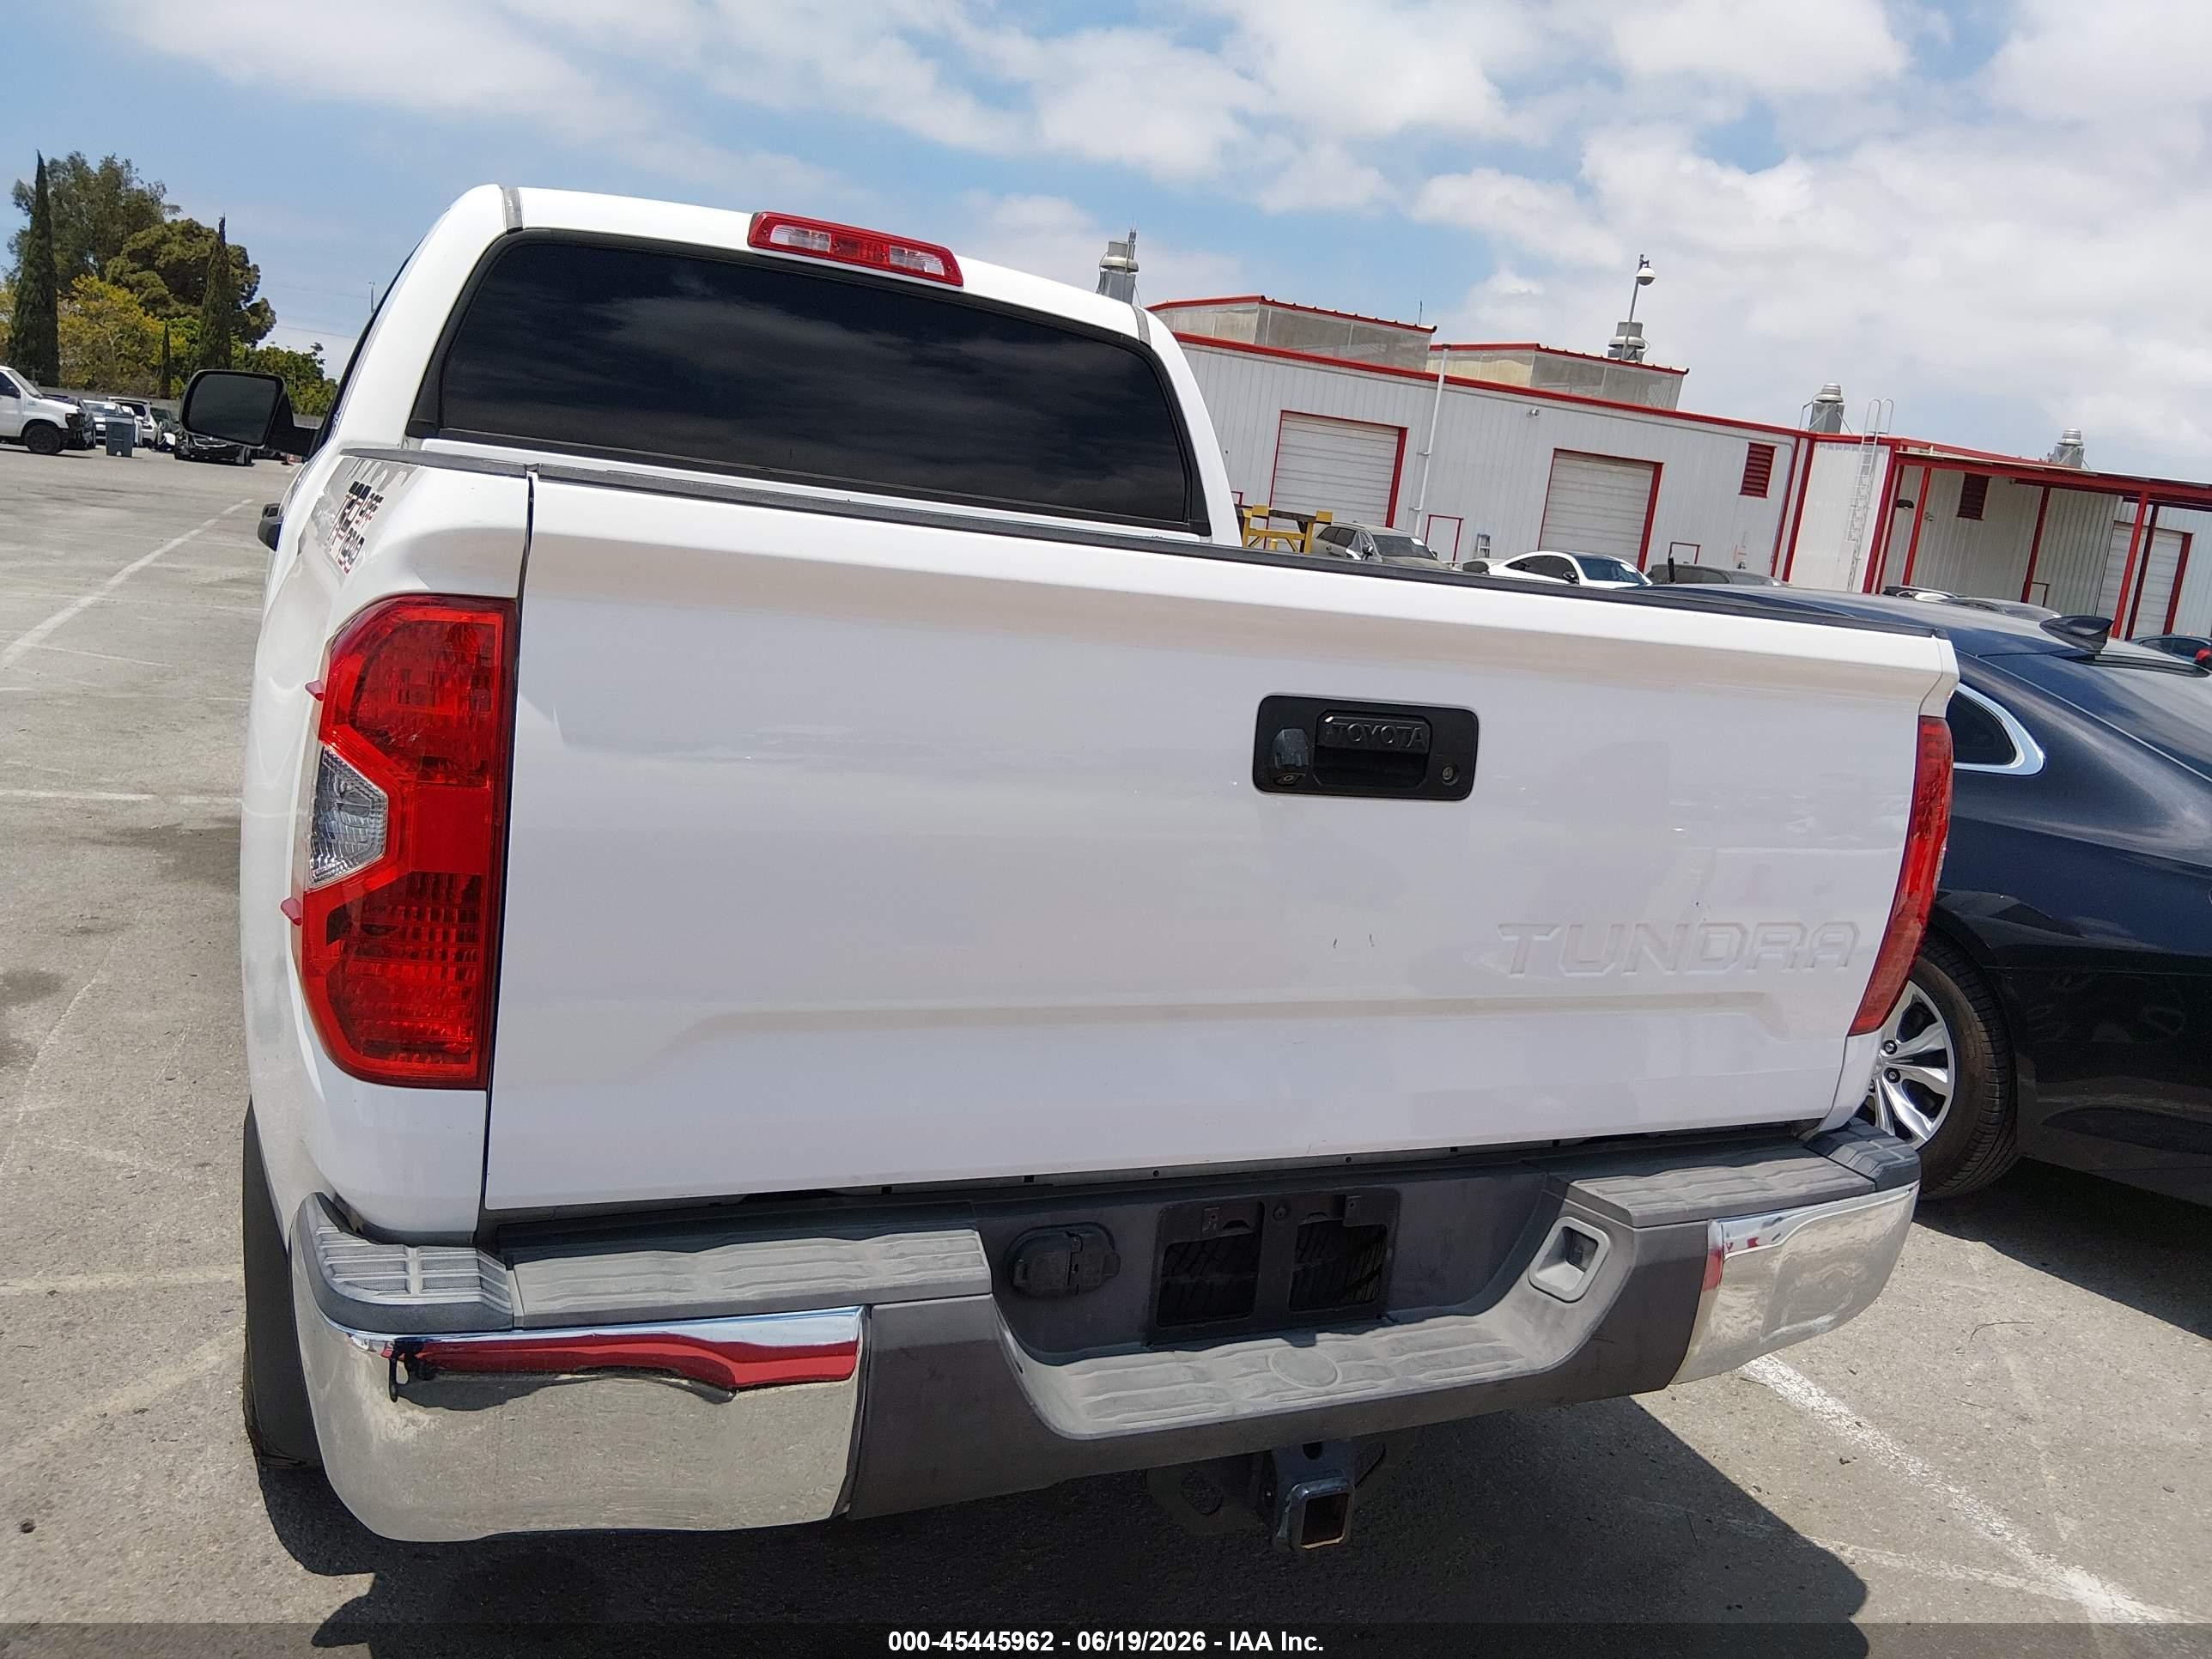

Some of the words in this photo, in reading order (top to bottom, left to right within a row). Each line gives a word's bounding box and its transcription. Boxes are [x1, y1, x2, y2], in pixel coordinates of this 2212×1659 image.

[327, 480, 373, 552] TRD
[1327, 720, 1425, 749] TOYOTA
[1497, 921, 1861, 977] TUNDRA
